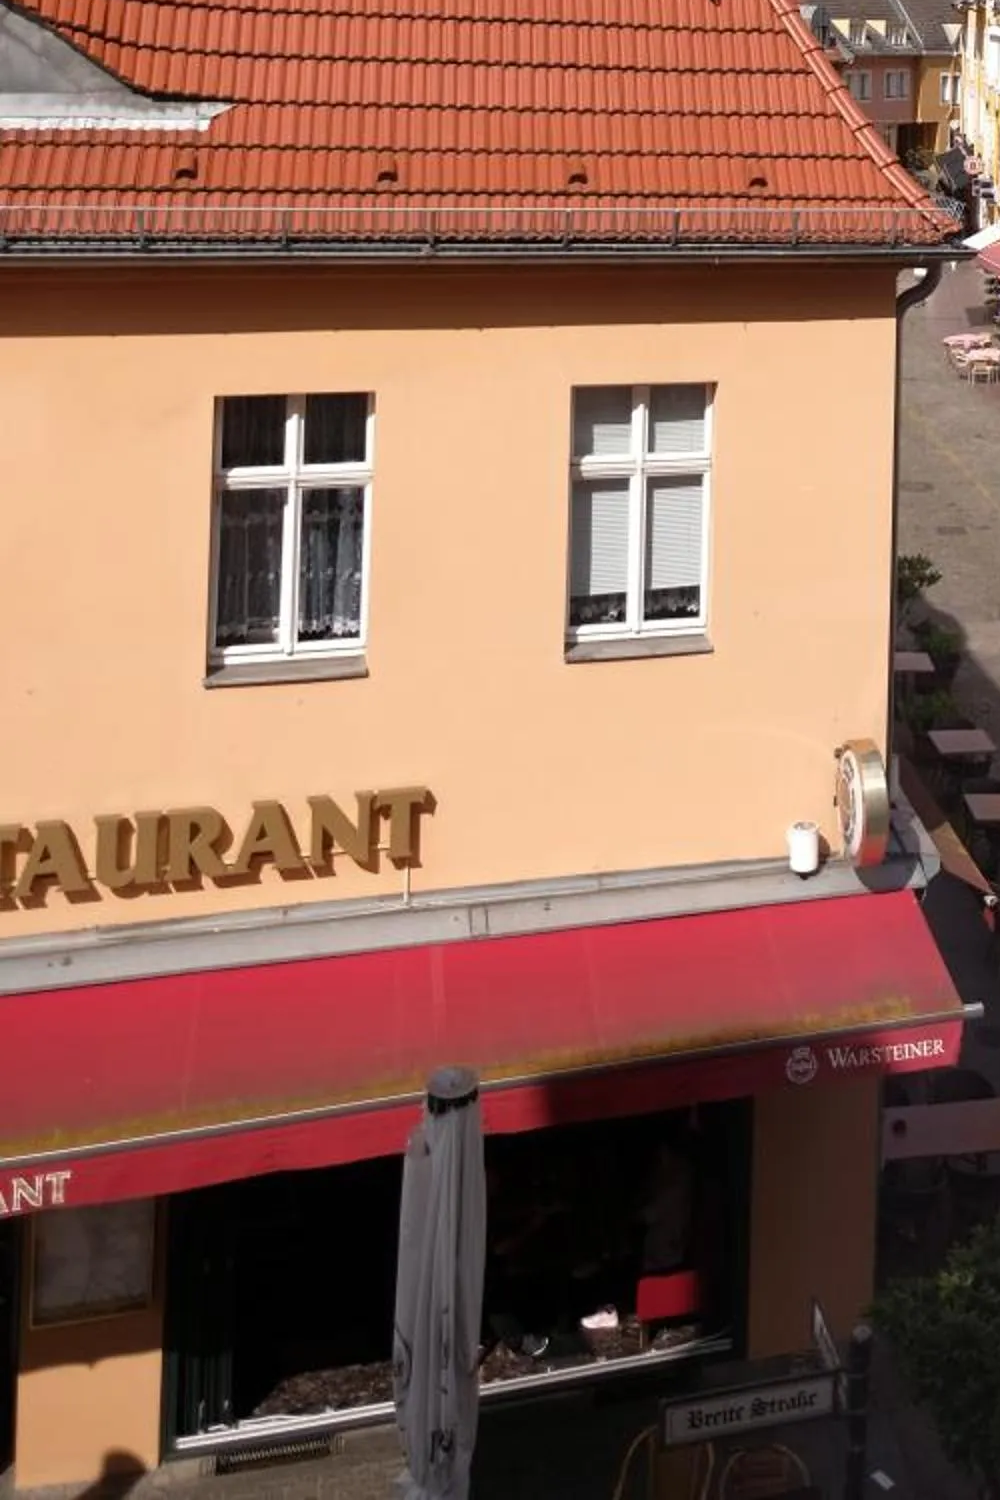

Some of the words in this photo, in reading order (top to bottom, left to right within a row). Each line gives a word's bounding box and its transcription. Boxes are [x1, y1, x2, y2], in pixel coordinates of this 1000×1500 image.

[827, 1038, 945, 1069] WARSTEINER
[686, 1405, 746, 1430] Breite
[751, 1389, 818, 1416] Straße
